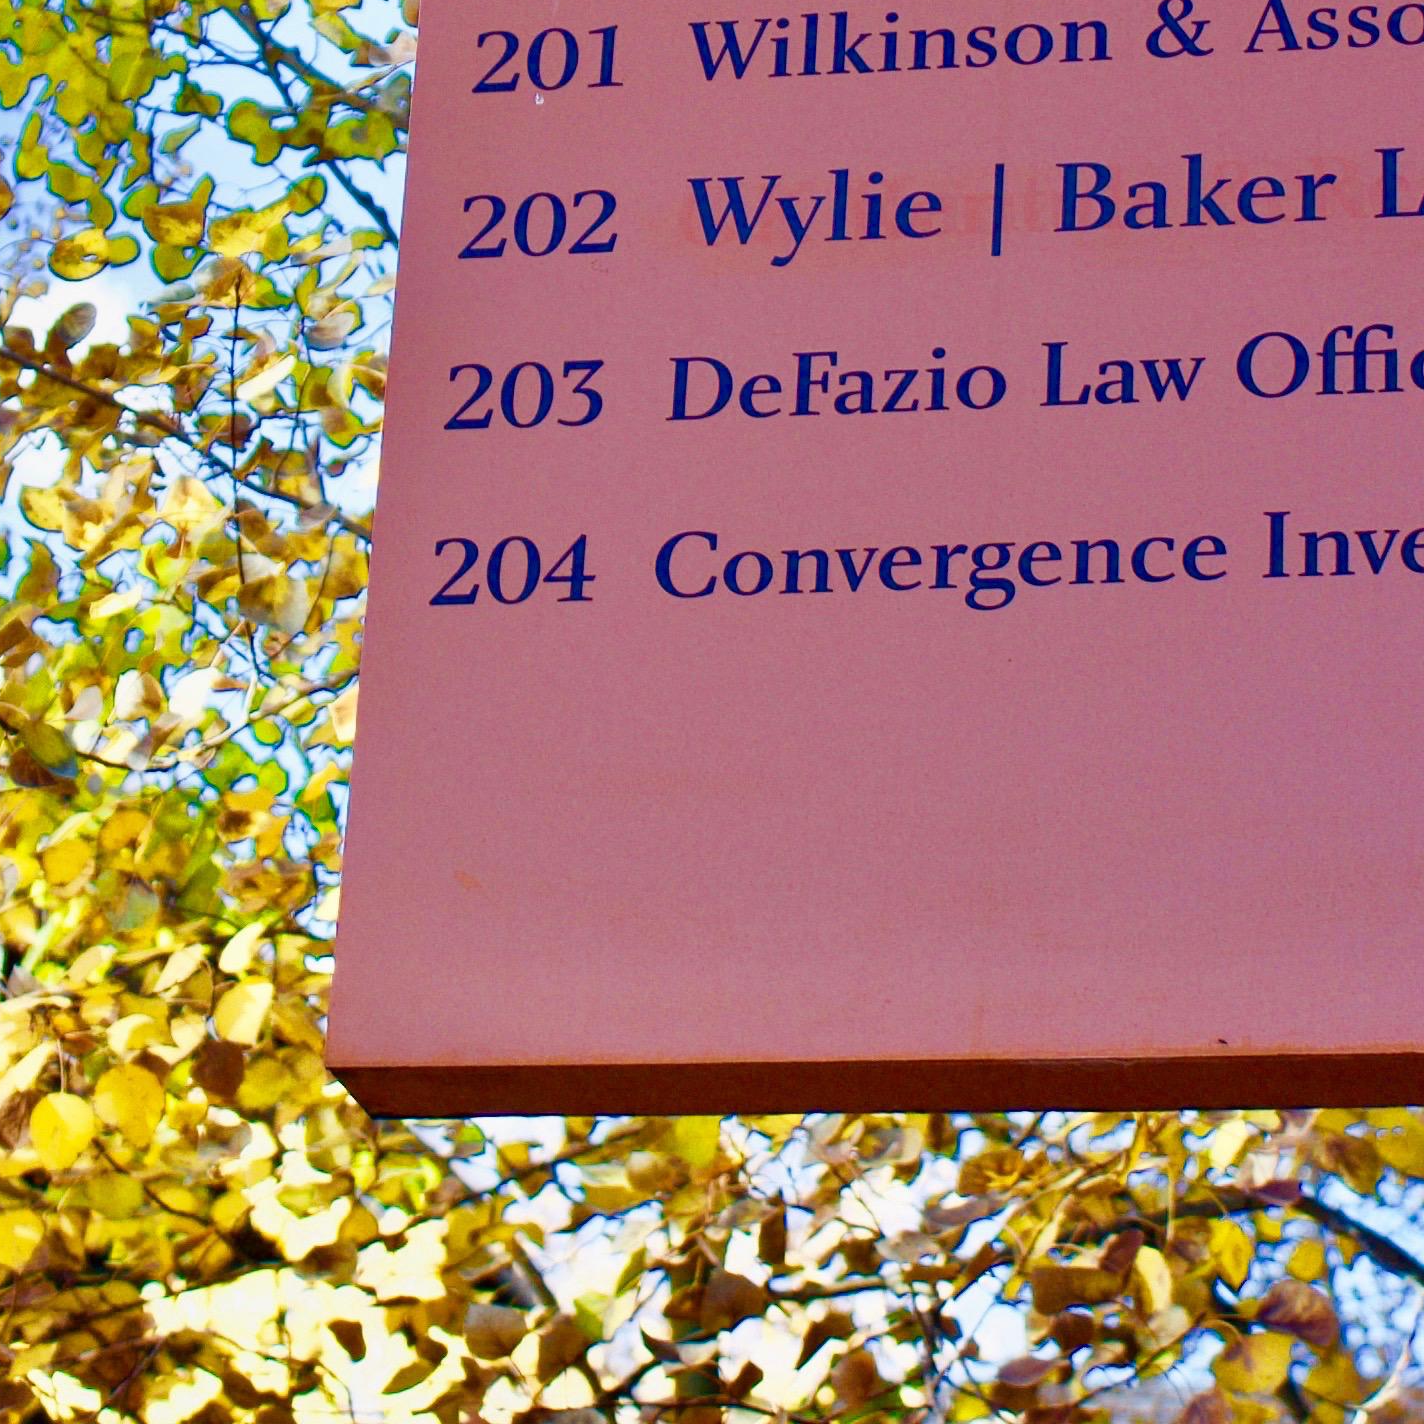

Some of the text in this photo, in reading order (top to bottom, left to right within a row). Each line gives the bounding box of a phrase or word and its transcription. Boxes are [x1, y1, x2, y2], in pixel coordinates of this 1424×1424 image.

[472, 25, 623, 93] 201
[688, 11, 1112, 81] Wilkinson
[458, 190, 617, 259] 202
[688, 169, 942, 267] Wylie
[991, 163, 1004, 256] |
[1054, 153, 1337, 232] Baker
[444, 360, 604, 430] 203
[666, 347, 1006, 420] DeFazio
[1040, 342, 1205, 406] Law
[429, 534, 596, 606] 204
[655, 531, 1227, 611] Convergence
